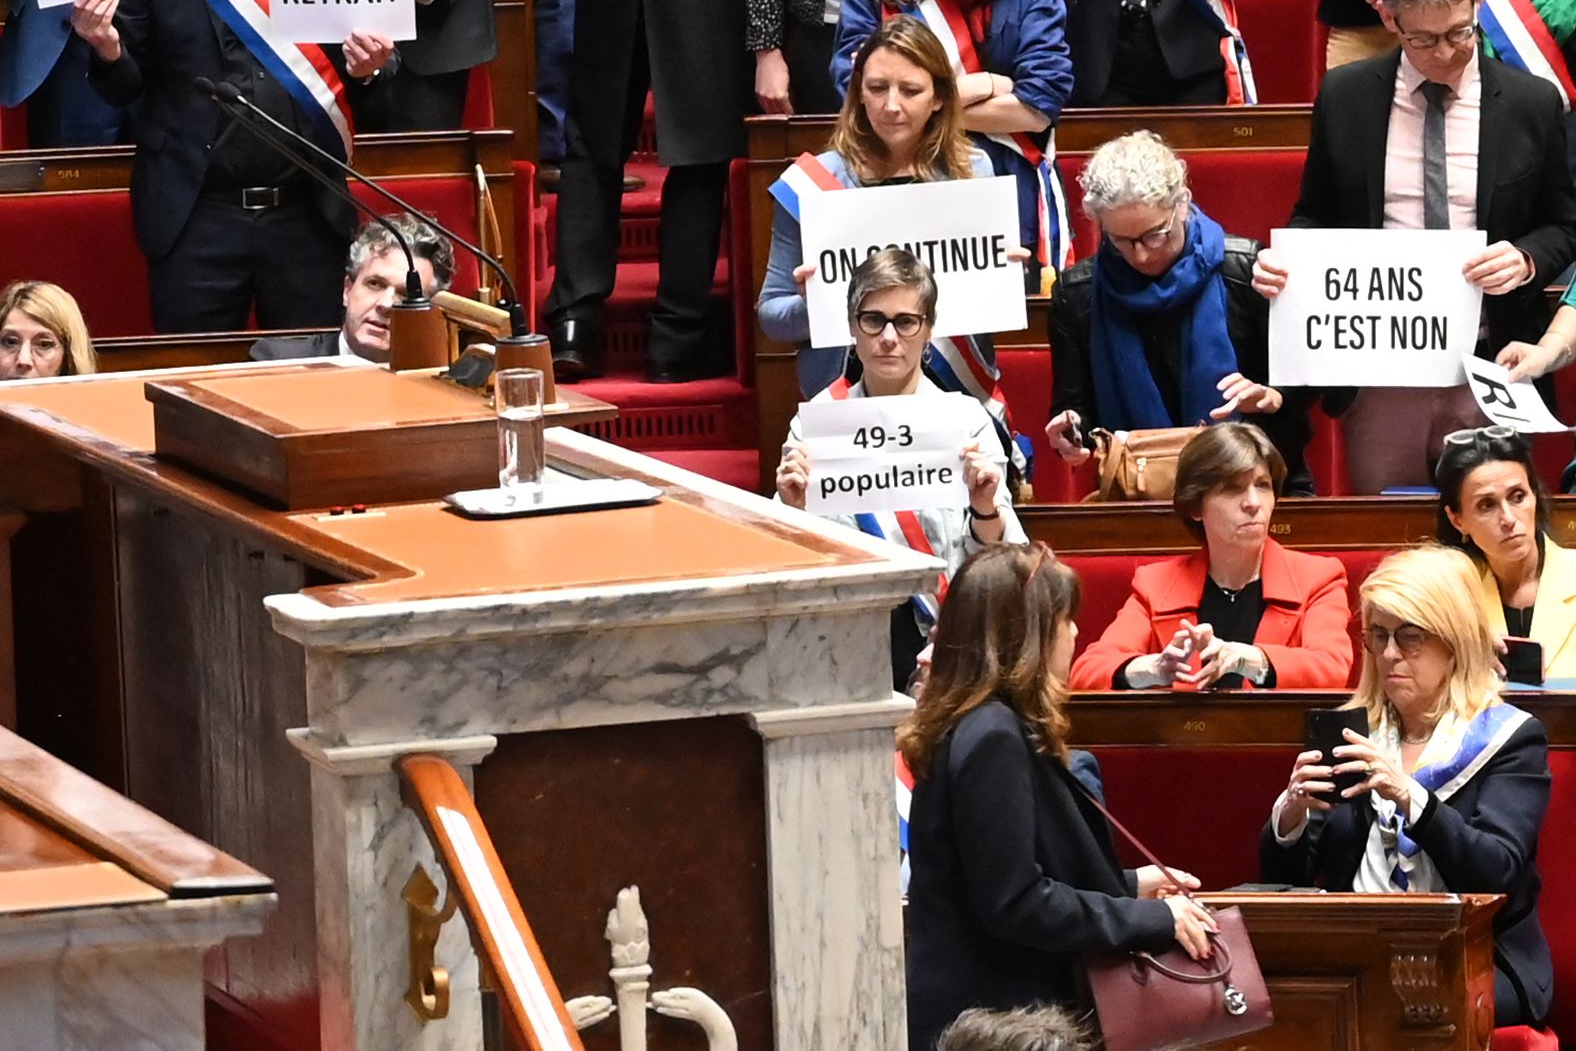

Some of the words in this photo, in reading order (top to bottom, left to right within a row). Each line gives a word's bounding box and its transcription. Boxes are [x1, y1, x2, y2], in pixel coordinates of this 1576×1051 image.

[1233, 126, 1253, 137] 501
[820, 248, 857, 284] ON
[1325, 268, 1359, 300] 64
[1368, 267, 1423, 301] ANS
[1307, 314, 1381, 350] C'EST
[1391, 316, 1447, 350] NON
[854, 425, 913, 448] 49-3
[821, 464, 952, 499] populaire
[1270, 523, 1291, 535] 493
